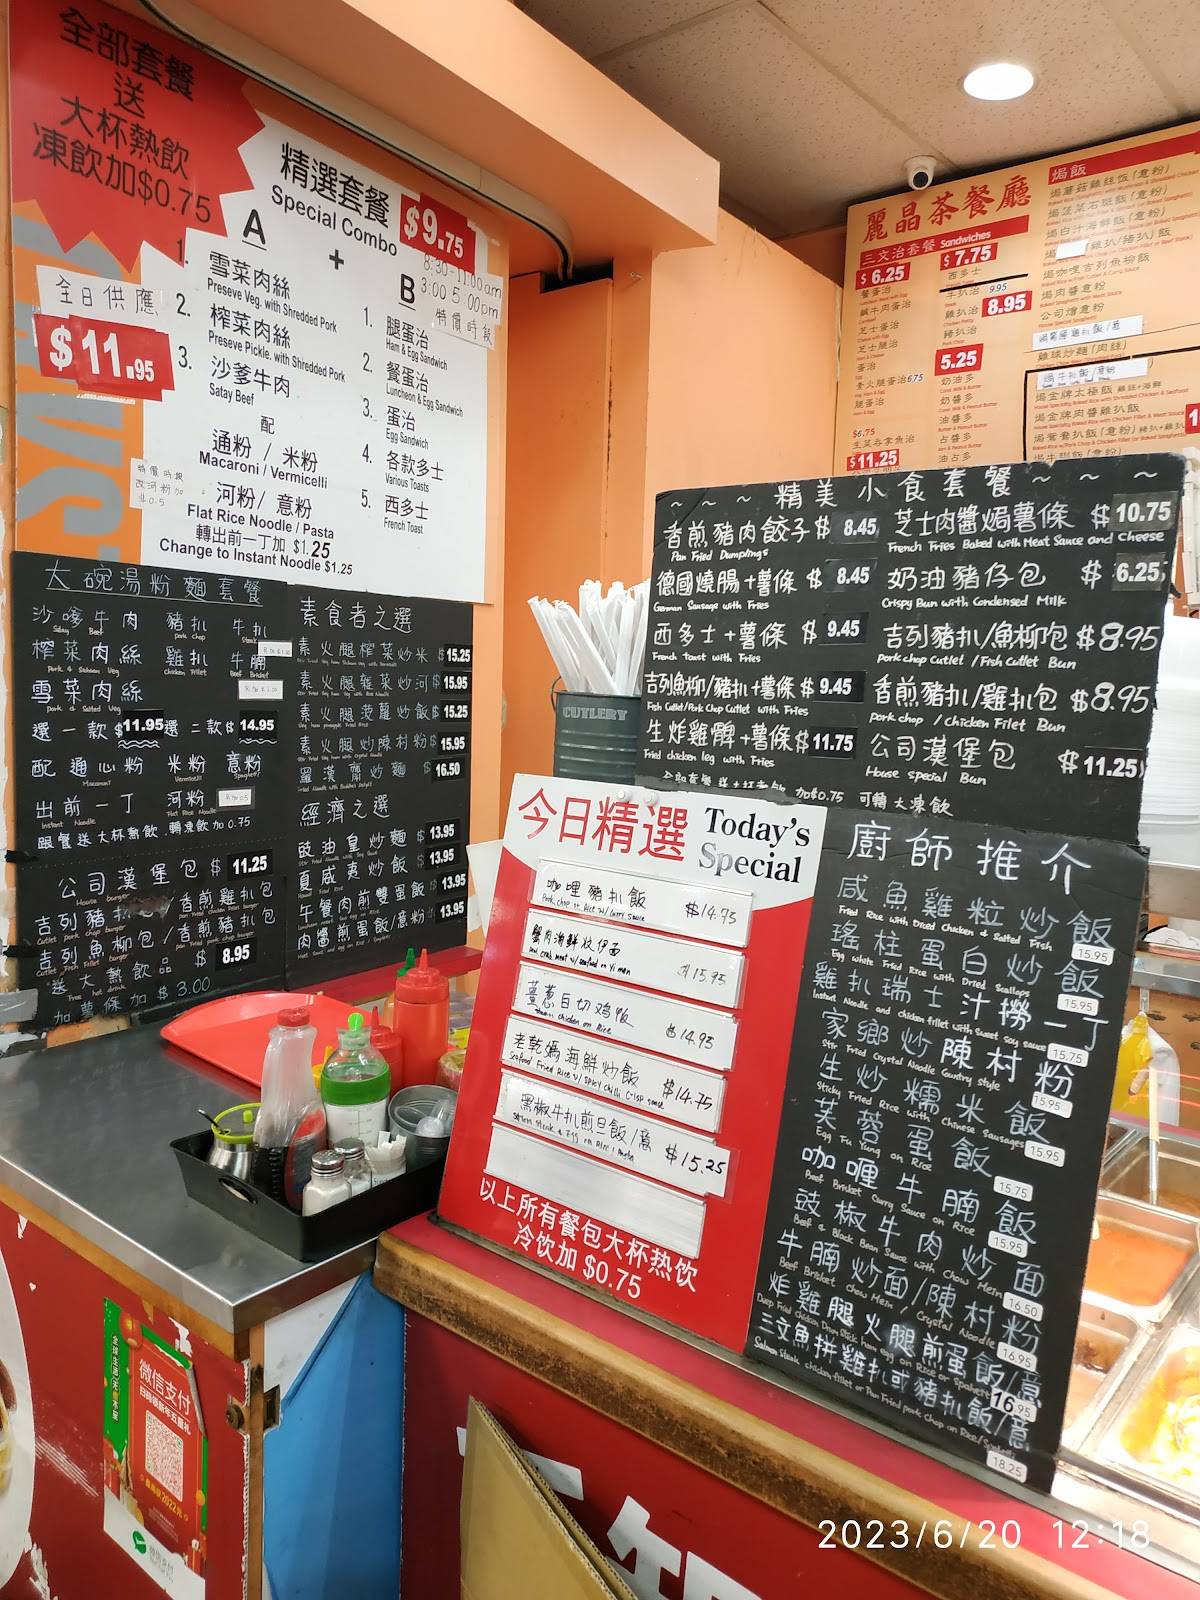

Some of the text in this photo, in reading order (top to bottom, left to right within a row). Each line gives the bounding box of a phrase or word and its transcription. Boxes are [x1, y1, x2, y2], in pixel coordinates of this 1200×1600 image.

[59, 7, 195, 101] 全部套餐
[113, 72, 145, 118] 送
[60, 96, 189, 180] 大杯熱飲
[280, 142, 389, 228] 精選套餐
[271, 185, 398, 256] Special Combo
[863, 174, 1031, 244] 麗晶茶餐廳
[243, 209, 266, 245] A
[404, 206, 464, 258] $9.75
[863, 231, 991, 265] 三文治套餐 Sandwiches
[208, 251, 290, 300] 雪菜肉絲
[400, 273, 415, 303] B
[56, 274, 159, 316] 全日供應
[207, 279, 337, 333] Preseve Veg. with Shredded Pork
[988, 294, 1026, 315] 8.95
[209, 303, 291, 349] 榨菜肉絲
[386, 316, 429, 351] 腿蛋治
[50, 325, 155, 382] $11.95
[209, 331, 345, 383] Preseve with Shredded Pork
[386, 338, 447, 371] Ham Egg Sandwich
[940, 350, 977, 370] 5.25
[210, 356, 290, 398] 沙爹牛肉
[386, 361, 429, 393] 餐蛋治
[209, 383, 255, 406] Satay Beef
[386, 383, 463, 418] Luncheon Egg Sandwich
[260, 416, 275, 435] 配
[387, 405, 415, 432] 蛋治
[212, 428, 318, 473] 通粉 米粉
[386, 427, 428, 449] Egg Sandwich
[199, 451, 327, 489] Macaroni Vermicelli
[386, 450, 444, 481] 各款多士
[385, 473, 429, 493] Various Toasts
[188, 504, 334, 539] Flat Rice Noodle Pasta
[277, 494, 312, 519] 意粉
[385, 494, 429, 520] 西多士
[196, 524, 330, 558] 轉出前一丁加 $1.25
[384, 517, 423, 534] French Toast
[664, 515, 810, 550] 香煎豬肉餃子
[159, 538, 353, 575] Change to Instant Noodle $1.25
[671, 549, 768, 562] Pan Fried Dumplings
[888, 532, 1112, 553] French Fries Baked with Meat Sauce and
[888, 561, 1046, 591] 奶油豬仔包
[300, 596, 412, 633] 素食者之選
[653, 600, 769, 612] German Sausage with Fries
[882, 594, 1066, 610] Crispy Bun with Condensed Milk
[1076, 622, 1160, 651] $8.95
[32, 680, 143, 704] 雪菜肉絲
[1071, 682, 1150, 713] $8.95
[563, 707, 627, 720] CUTLERY
[168, 754, 205, 773] 米粉
[644, 750, 775, 767] Fried chicken leg with Fries
[870, 733, 1015, 770] 公司漢堡包
[866, 766, 899, 779] House
[960, 774, 987, 785] Bun
[37, 793, 133, 819] 出前一丁
[168, 789, 204, 808] 河粉
[300, 794, 390, 826] 經濟之選
[518, 787, 688, 862] 今日精選
[705, 808, 810, 847] Today's
[699, 842, 801, 883] Special
[848, 820, 1091, 895] 廚師推介
[58, 856, 267, 900] 公司漢堡包 11.25
[442, 874, 466, 890] 13.95
[440, 901, 464, 918] 13.95
[839, 905, 858, 918] Fried
[866, 909, 883, 923] Rice
[889, 916, 908, 926] with
[941, 923, 974, 937] Chicken
[993, 933, 1020, 945] Salted
[1029, 938, 1052, 951] Fish
[222, 944, 250, 964] 8.95
[1078, 948, 1108, 963] 15.95
[1064, 998, 1093, 1012] 15.95
[1052, 1048, 1082, 1064] 15.75
[1033, 1094, 1061, 1111] 15.95
[665, 1144, 725, 1174] $15.25
[1029, 1145, 1060, 1162] 15.95
[998, 1181, 1028, 1199] 15.75
[479, 1177, 698, 1292] 以上所有餐包大杯热饮
[993, 1236, 1023, 1253] 15.95
[513, 1221, 642, 1299] 冷饮加 $0.75
[1008, 1297, 1038, 1315] 16.50
[1002, 1348, 1032, 1368] 16.95
[139, 1360, 191, 1415] 微信支付
[992, 1457, 1022, 1476] 18.25
